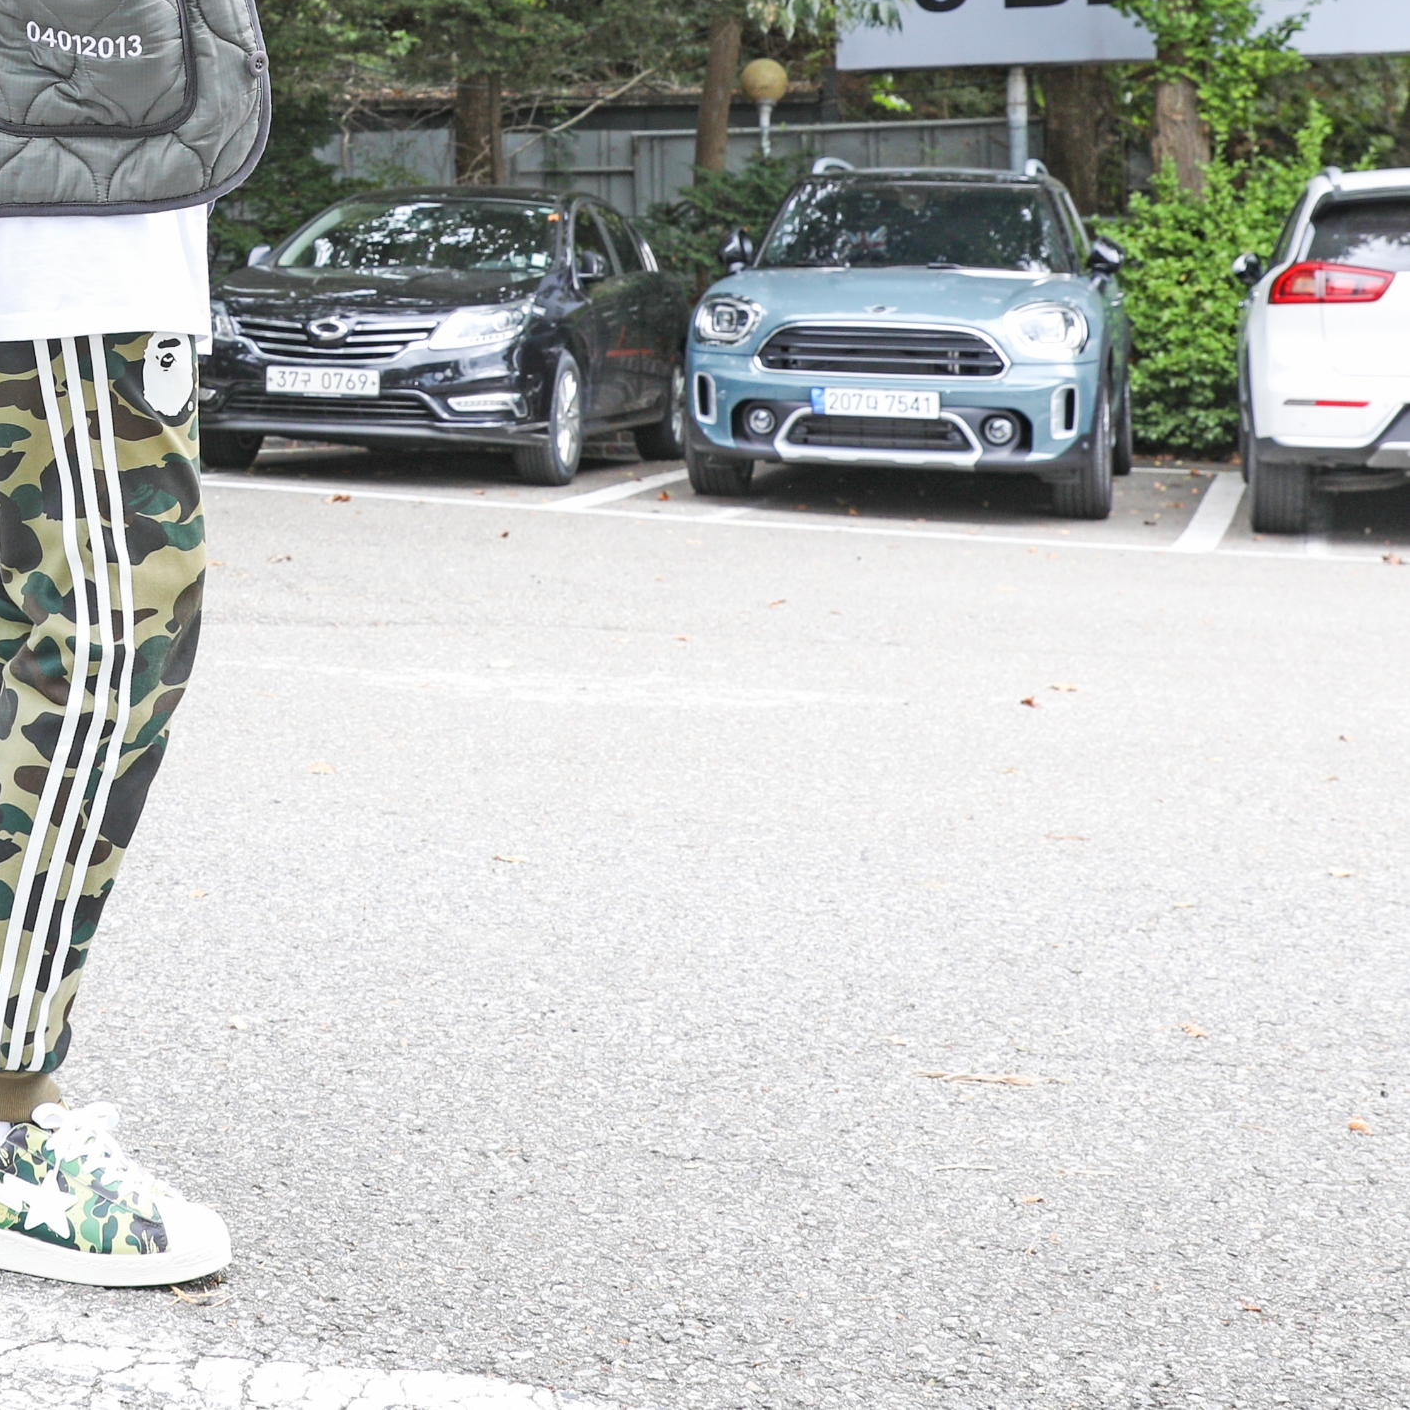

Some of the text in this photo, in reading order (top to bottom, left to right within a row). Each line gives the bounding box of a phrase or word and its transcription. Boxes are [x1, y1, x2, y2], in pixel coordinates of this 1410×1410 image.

[26, 20, 143, 59] 04012013
[321, 372, 369, 390] 0769
[885, 394, 931, 414] 7541
